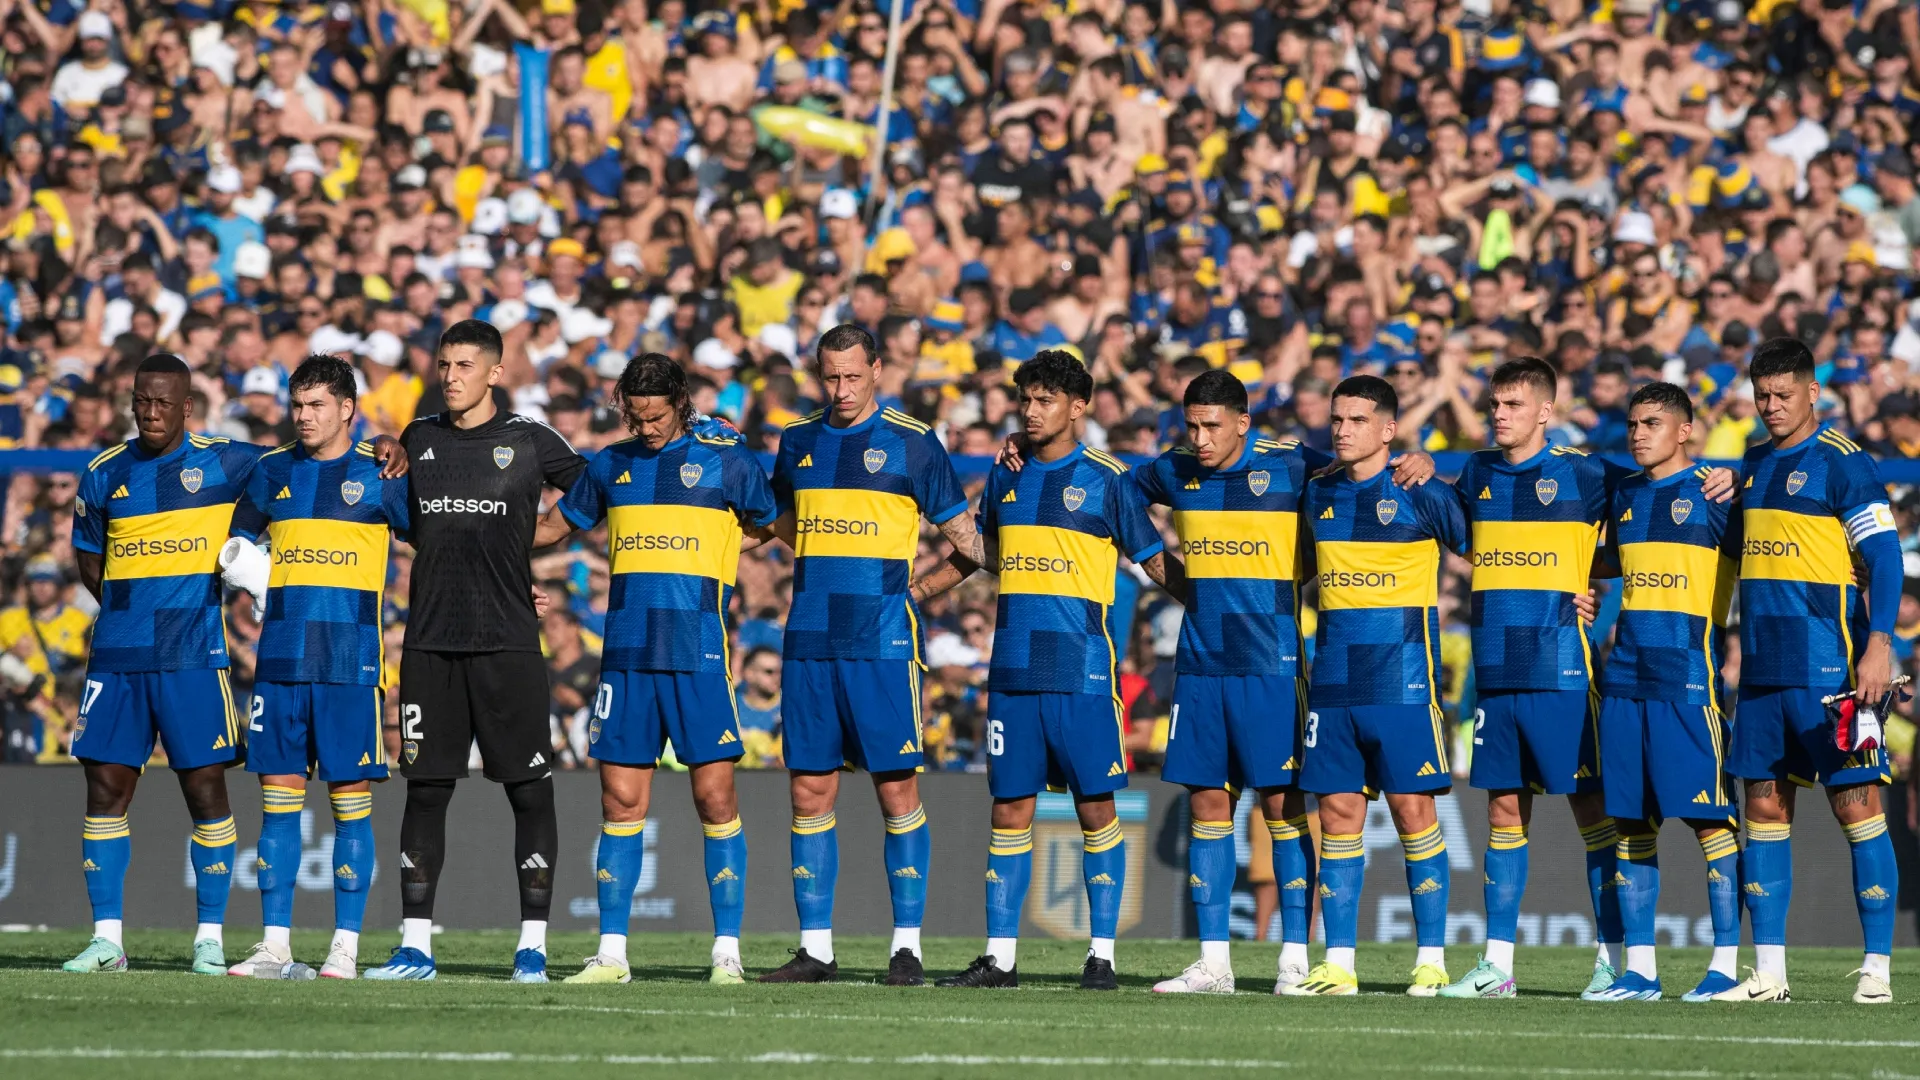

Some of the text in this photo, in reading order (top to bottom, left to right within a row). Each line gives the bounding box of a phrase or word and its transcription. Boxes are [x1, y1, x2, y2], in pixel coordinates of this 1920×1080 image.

[419, 496, 506, 515] betsson
[114, 536, 207, 558] betsson
[1742, 537, 1799, 557] etsson
[1317, 569, 1396, 588] etsson
[1623, 569, 1688, 589] etsson
[80, 679, 104, 714] 17
[249, 695, 264, 732] 2
[594, 682, 613, 719] 10
[401, 703, 424, 739] 12
[986, 718, 1004, 756] 6
[1304, 711, 1319, 748] 3
